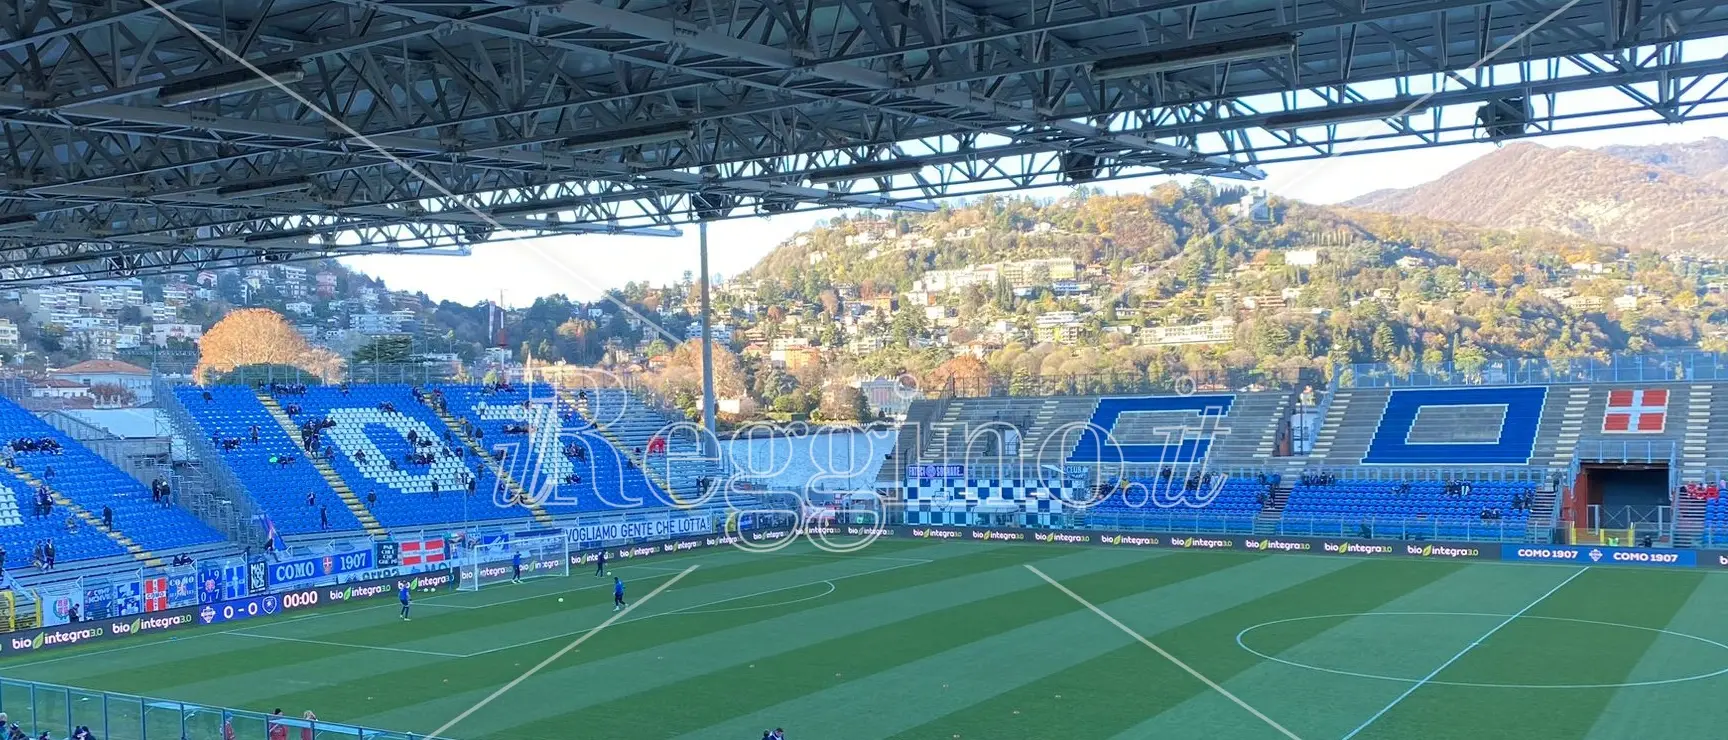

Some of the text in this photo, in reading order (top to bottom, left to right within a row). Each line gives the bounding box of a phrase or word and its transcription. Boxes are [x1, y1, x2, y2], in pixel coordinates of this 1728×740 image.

[565, 524, 617, 542] VOGLIAMO
[621, 522, 653, 538] GENTE
[656, 519, 675, 535] CHE
[678, 516, 711, 532] LOTTA!
[913, 529, 924, 537] bio
[972, 530, 984, 539] bio
[1035, 532, 1048, 541] bio
[1102, 535, 1113, 543] bio
[1171, 538, 1184, 546] bio
[1245, 540, 1259, 548] bio
[1324, 542, 1338, 551] bio
[1407, 545, 1422, 554] bio
[1518, 549, 1579, 559] COMO 1907
[1613, 552, 1678, 563] COMO 1907
[276, 561, 315, 581] COMO
[340, 552, 366, 571] 1907
[283, 590, 318, 608] 00:00
[330, 589, 343, 600] bio
[112, 623, 130, 634] bio
[12, 638, 32, 650] bio
